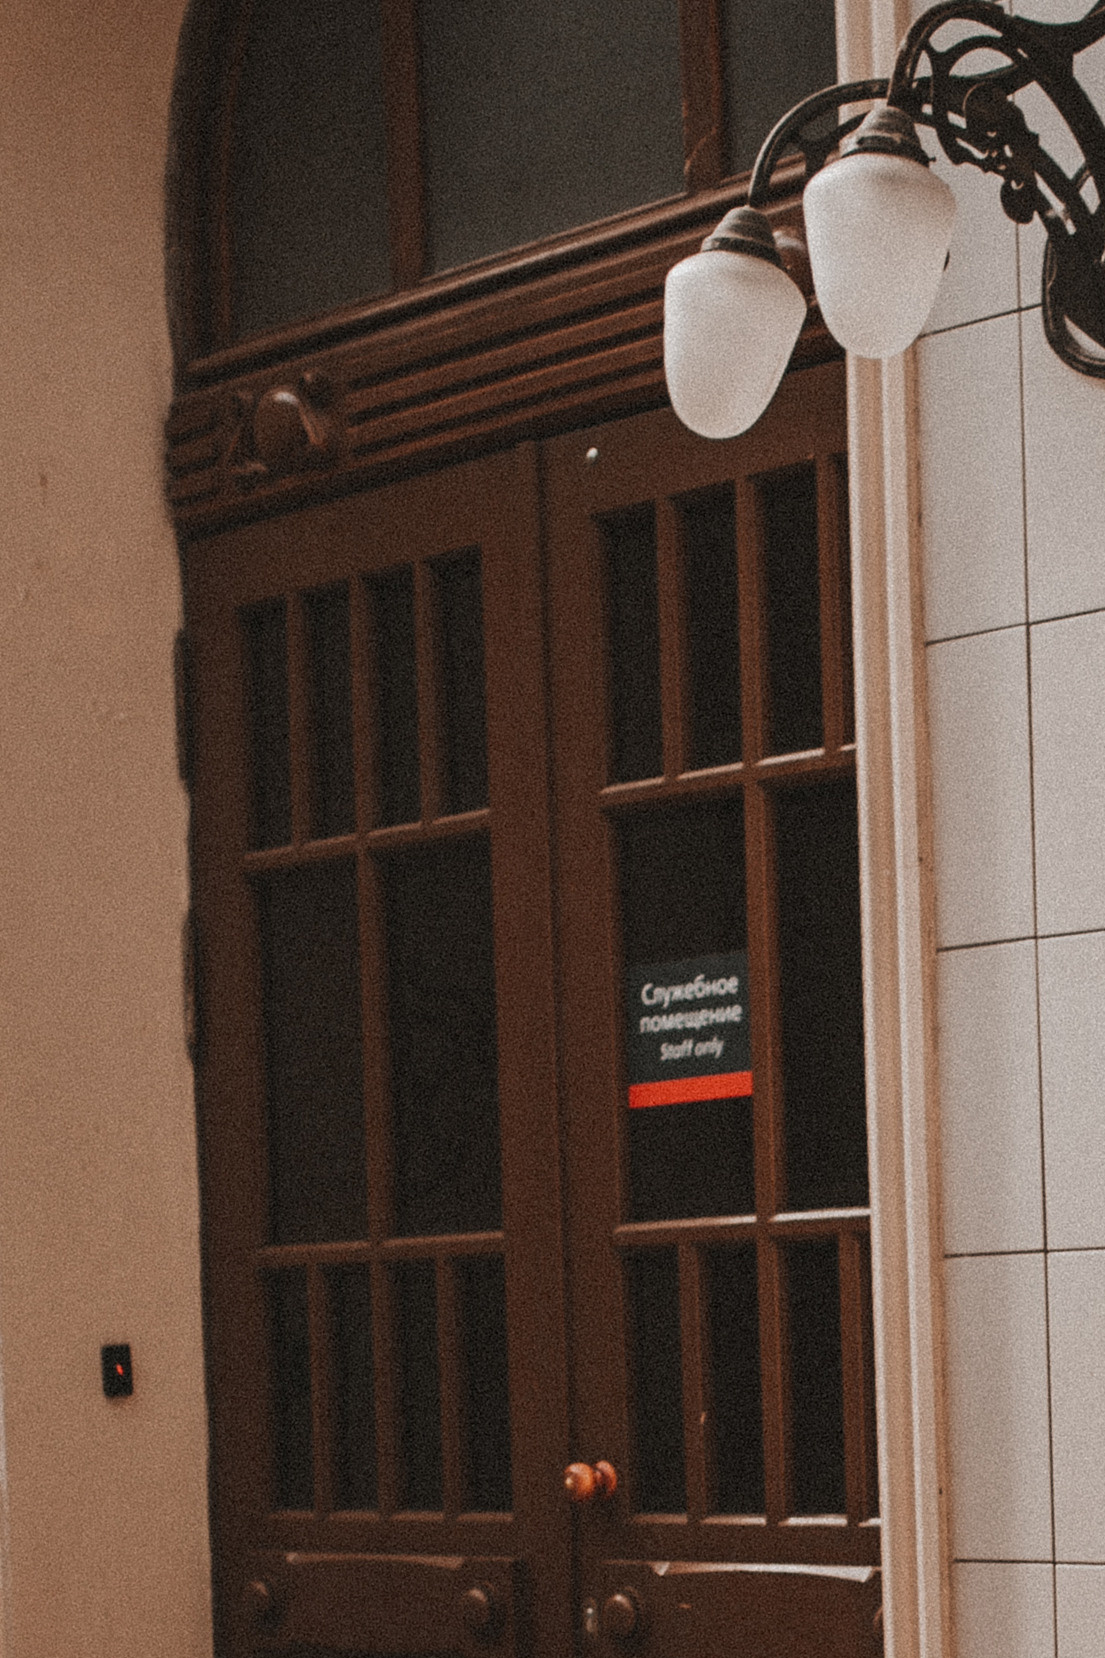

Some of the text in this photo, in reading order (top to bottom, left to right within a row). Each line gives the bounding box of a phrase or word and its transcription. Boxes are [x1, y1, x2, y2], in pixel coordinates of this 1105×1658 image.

[641, 974, 739, 1009] Служебное
[640, 1004, 743, 1033] помещение
[660, 1036, 725, 1061] Staff only
